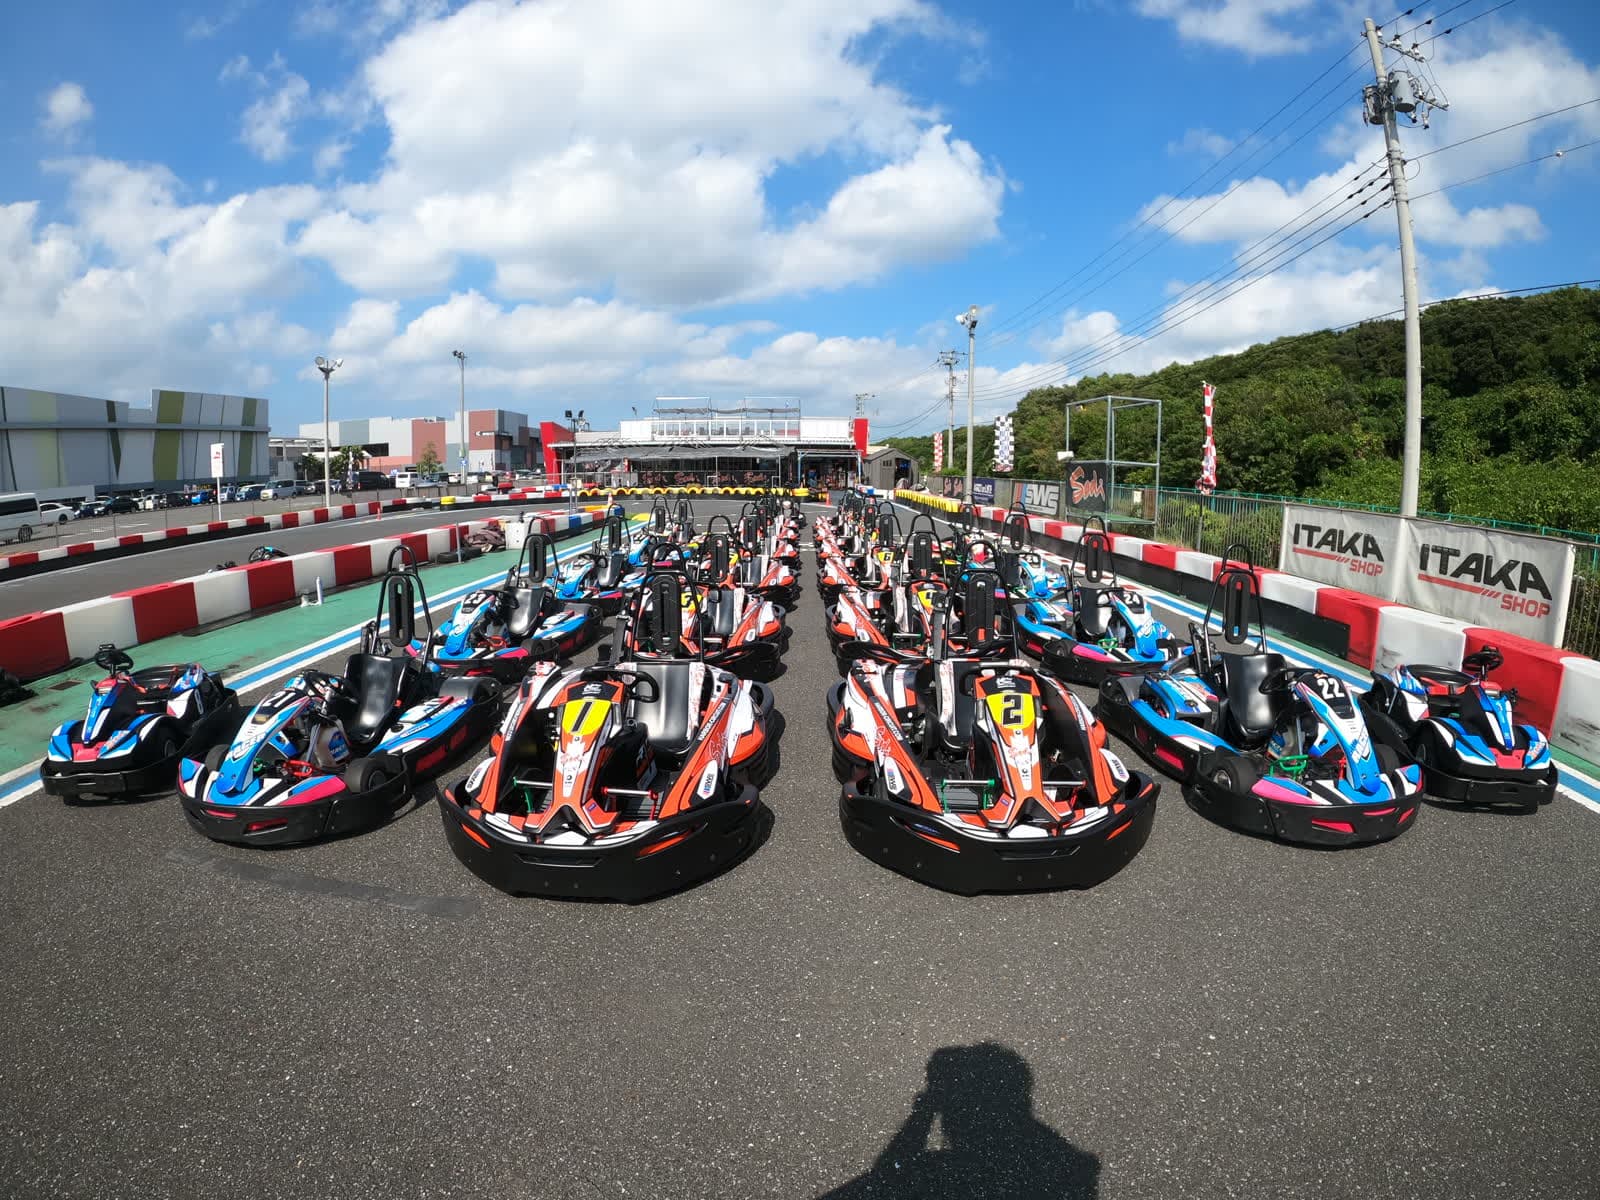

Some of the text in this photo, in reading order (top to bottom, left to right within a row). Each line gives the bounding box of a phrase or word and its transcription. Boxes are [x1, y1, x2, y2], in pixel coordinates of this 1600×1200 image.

[1025, 484, 1059, 515] SWS
[1293, 523, 1384, 562] ITAKA
[1350, 559, 1383, 577] SHOP
[1420, 543, 1552, 600] ITAKA
[1501, 593, 1551, 618] SHOP
[262, 690, 297, 708] 21
[1317, 678, 1345, 700] 22
[569, 700, 595, 733] 1
[1002, 693, 1023, 727] 2
